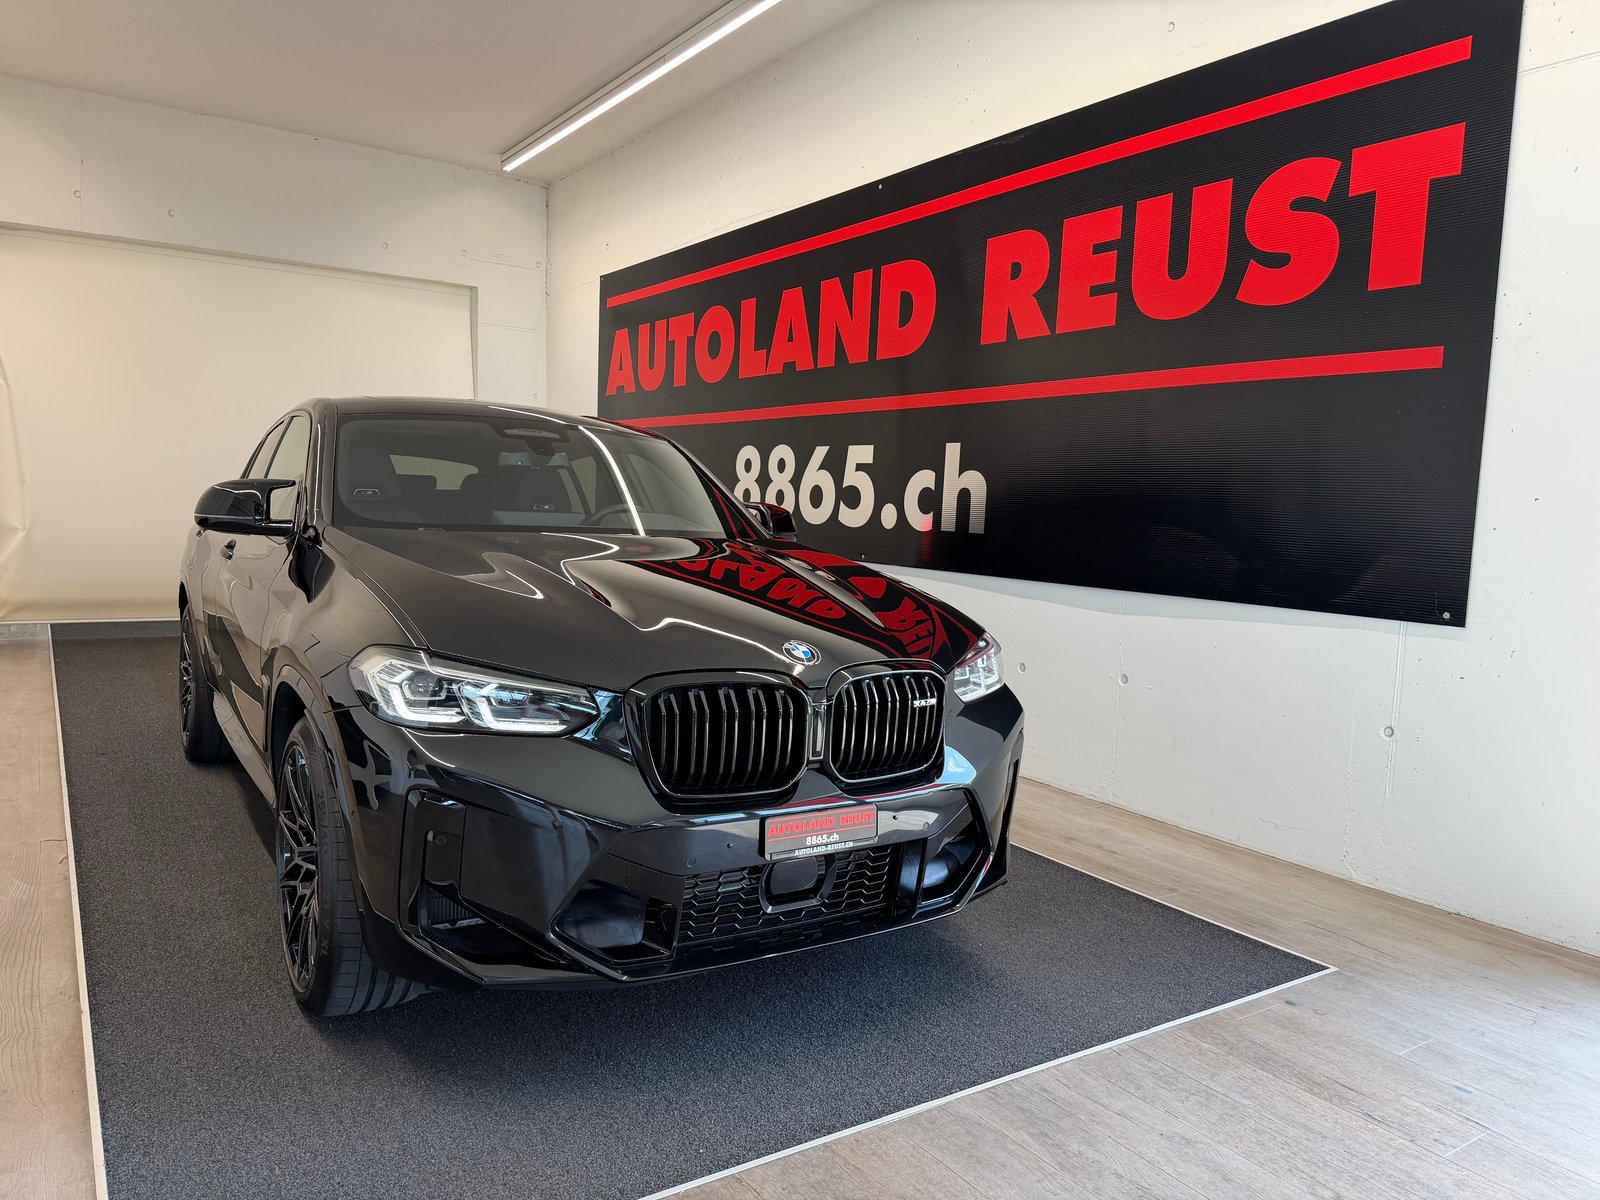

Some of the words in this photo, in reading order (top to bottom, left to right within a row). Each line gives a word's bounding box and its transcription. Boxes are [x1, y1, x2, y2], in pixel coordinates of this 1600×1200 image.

[605, 259, 937, 396] AUTOLAND
[981, 122, 1466, 345] REUST
[733, 442, 987, 534] 8865.ch
[767, 817, 835, 836] AUTOLAND
[839, 811, 875, 826] REUST
[794, 841, 854, 856] AUTOLAND-REUST.CH
[806, 833, 840, 845] 8865.ch
